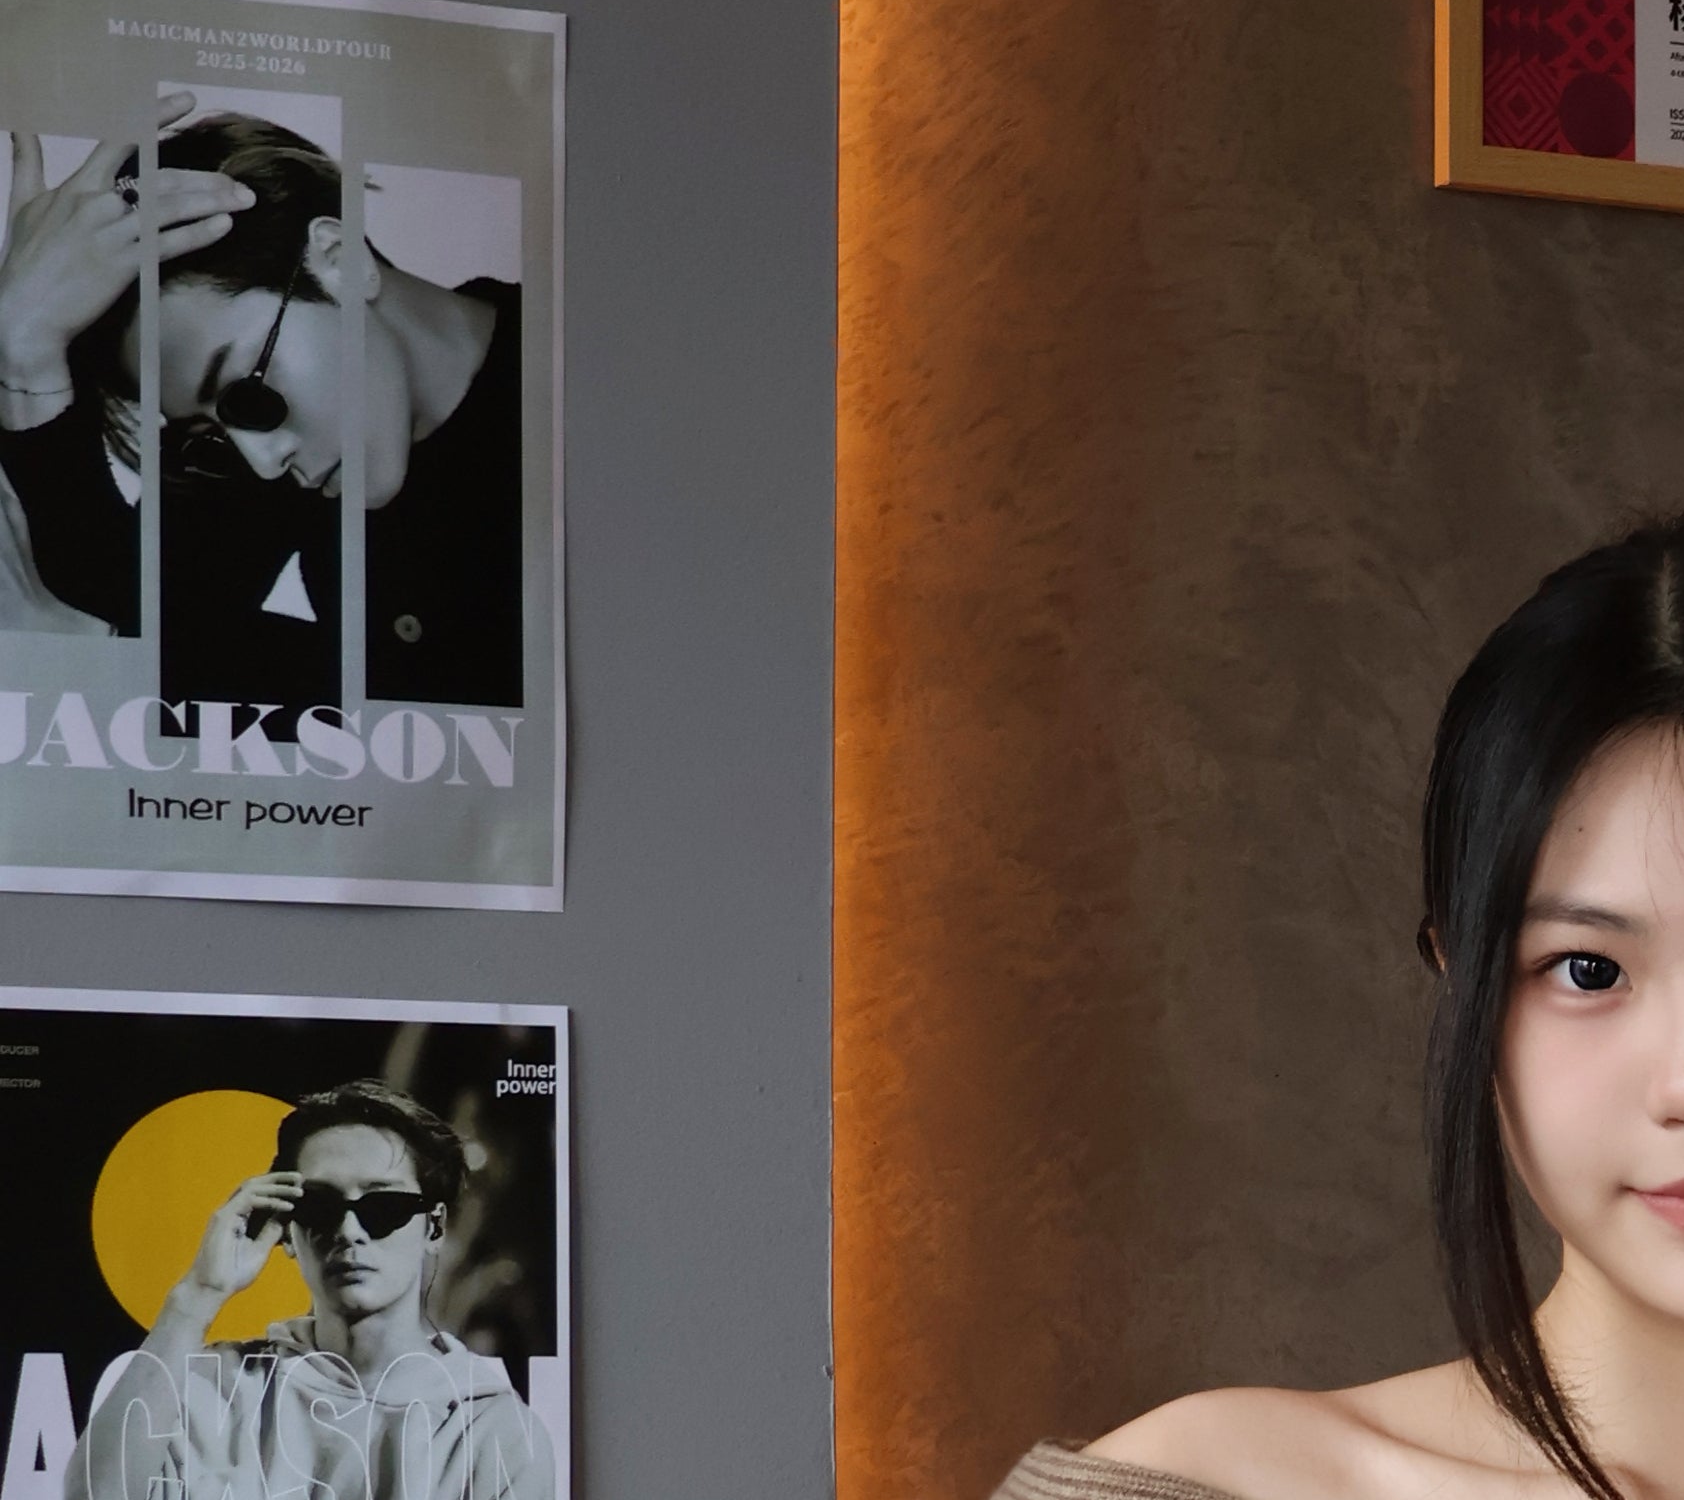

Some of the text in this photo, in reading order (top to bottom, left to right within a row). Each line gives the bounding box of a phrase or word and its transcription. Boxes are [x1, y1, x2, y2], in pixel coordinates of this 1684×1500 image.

[107, 18, 393, 61] MAGICMAN2WORLDTOUR
[195, 49, 307, 75] 2025-2026
[0, 690, 524, 789] JACKSON
[128, 787, 374, 830] Inner power
[507, 1059, 557, 1078] Inner
[496, 1079, 557, 1098] power
